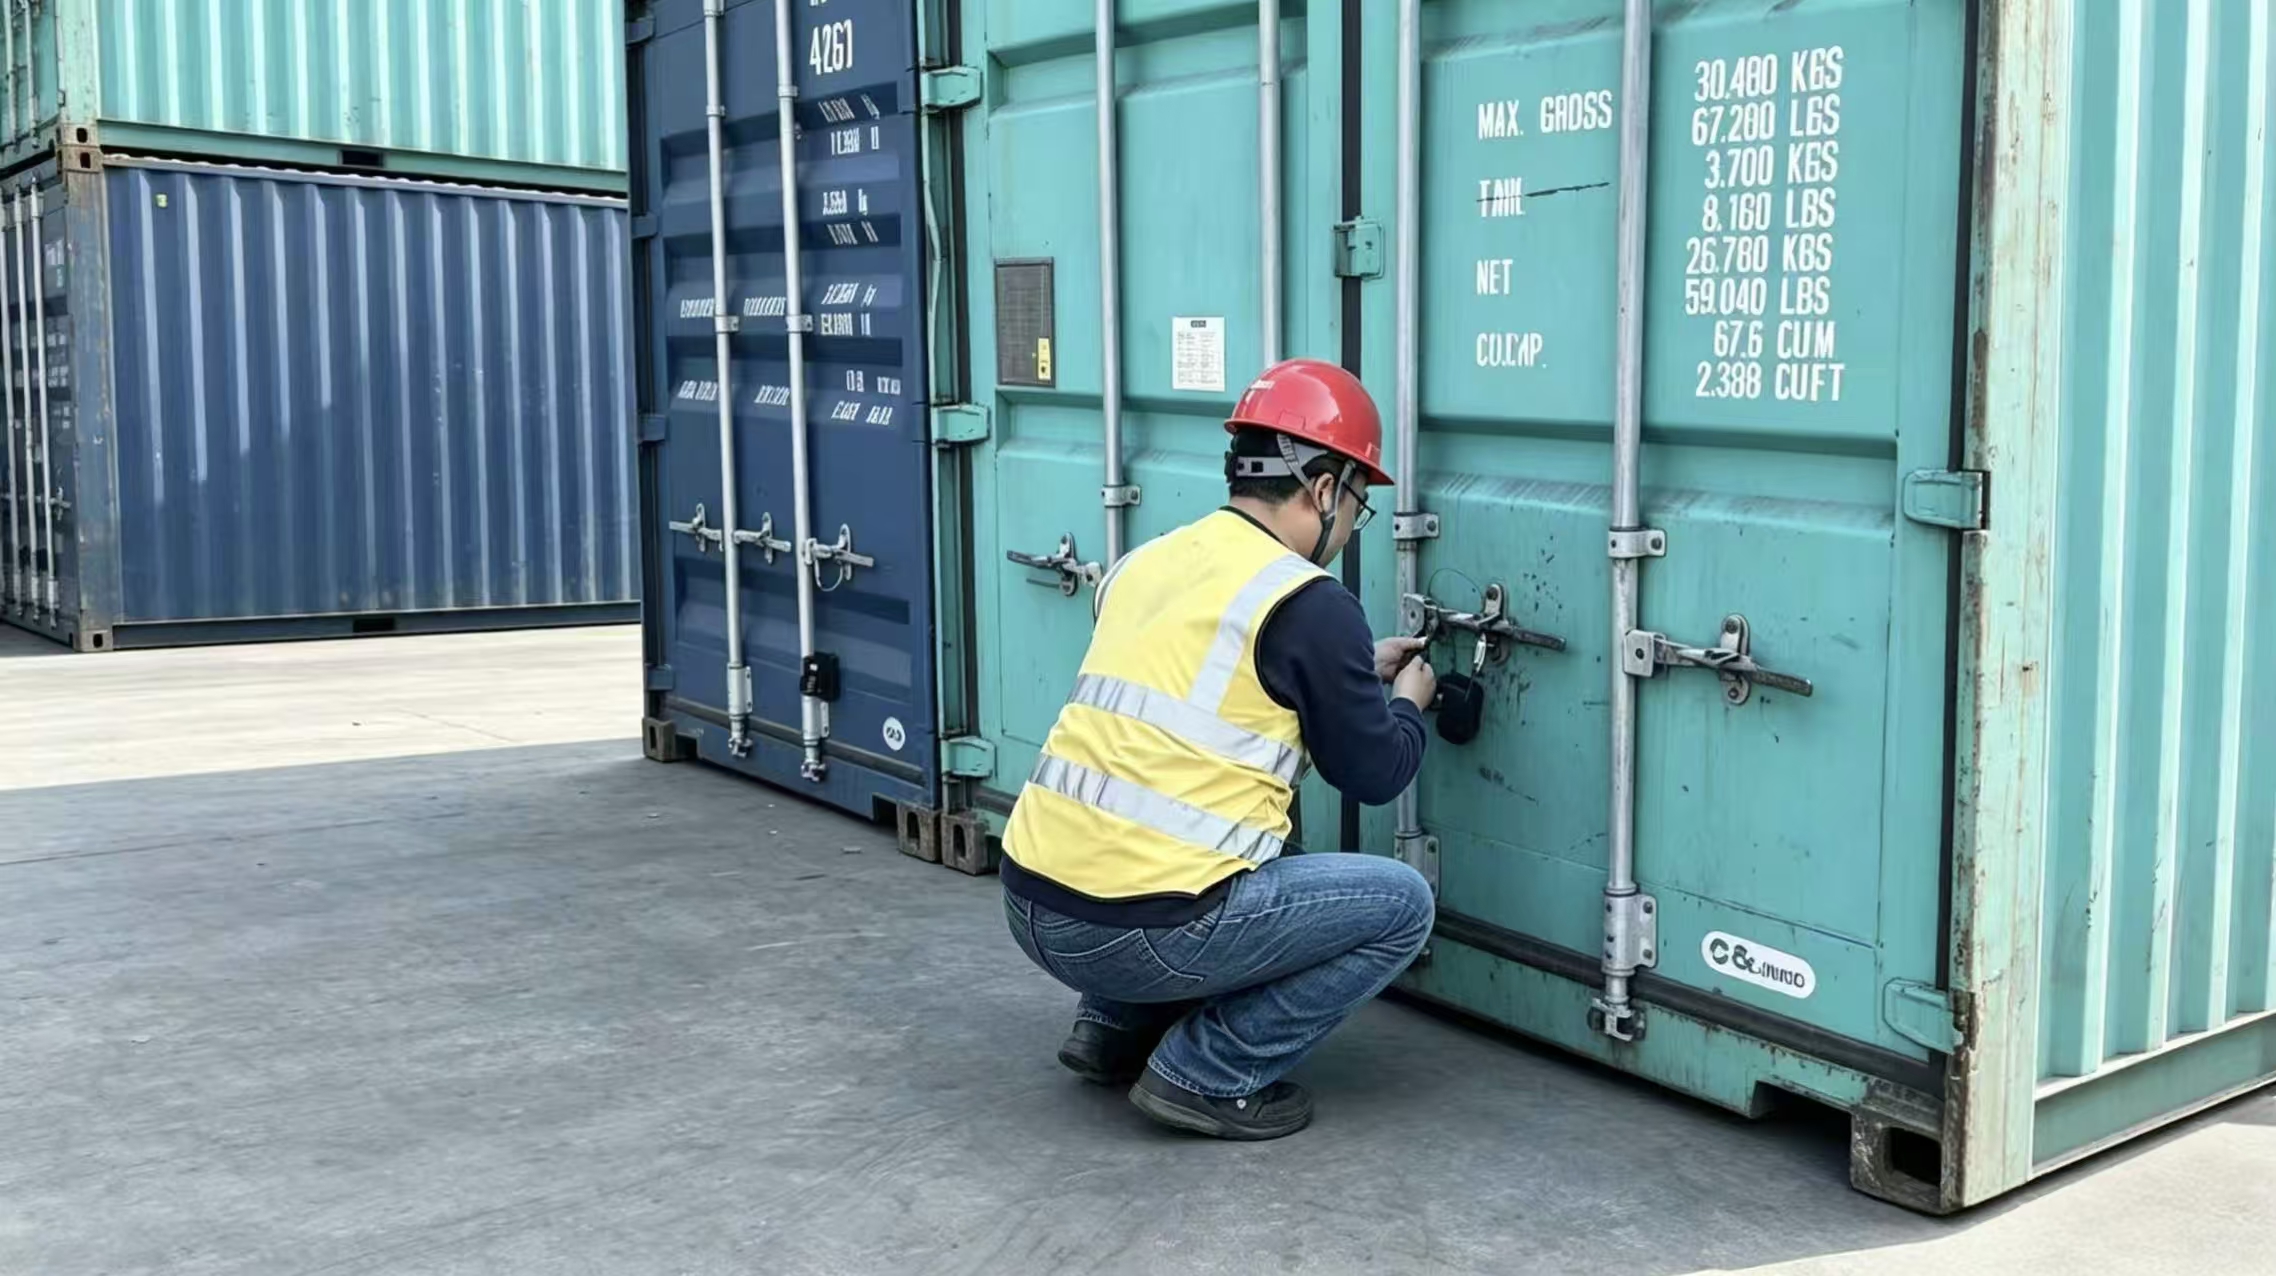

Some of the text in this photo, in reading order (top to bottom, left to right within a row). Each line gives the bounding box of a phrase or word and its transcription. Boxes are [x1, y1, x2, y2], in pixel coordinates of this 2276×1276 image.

[1791, 45, 1844, 93] KGS
[1477, 99, 1524, 139] MAX.
[1704, 140, 1839, 189] 3.700 KGS
[1785, 186, 1836, 229] LBS
[1685, 234, 1769, 275] 26.780
[1476, 258, 1514, 296] NET
[1684, 275, 1831, 315] 59.040 LBS
[1713, 319, 1764, 359] 67.6
[1695, 360, 1762, 399] 2.388
